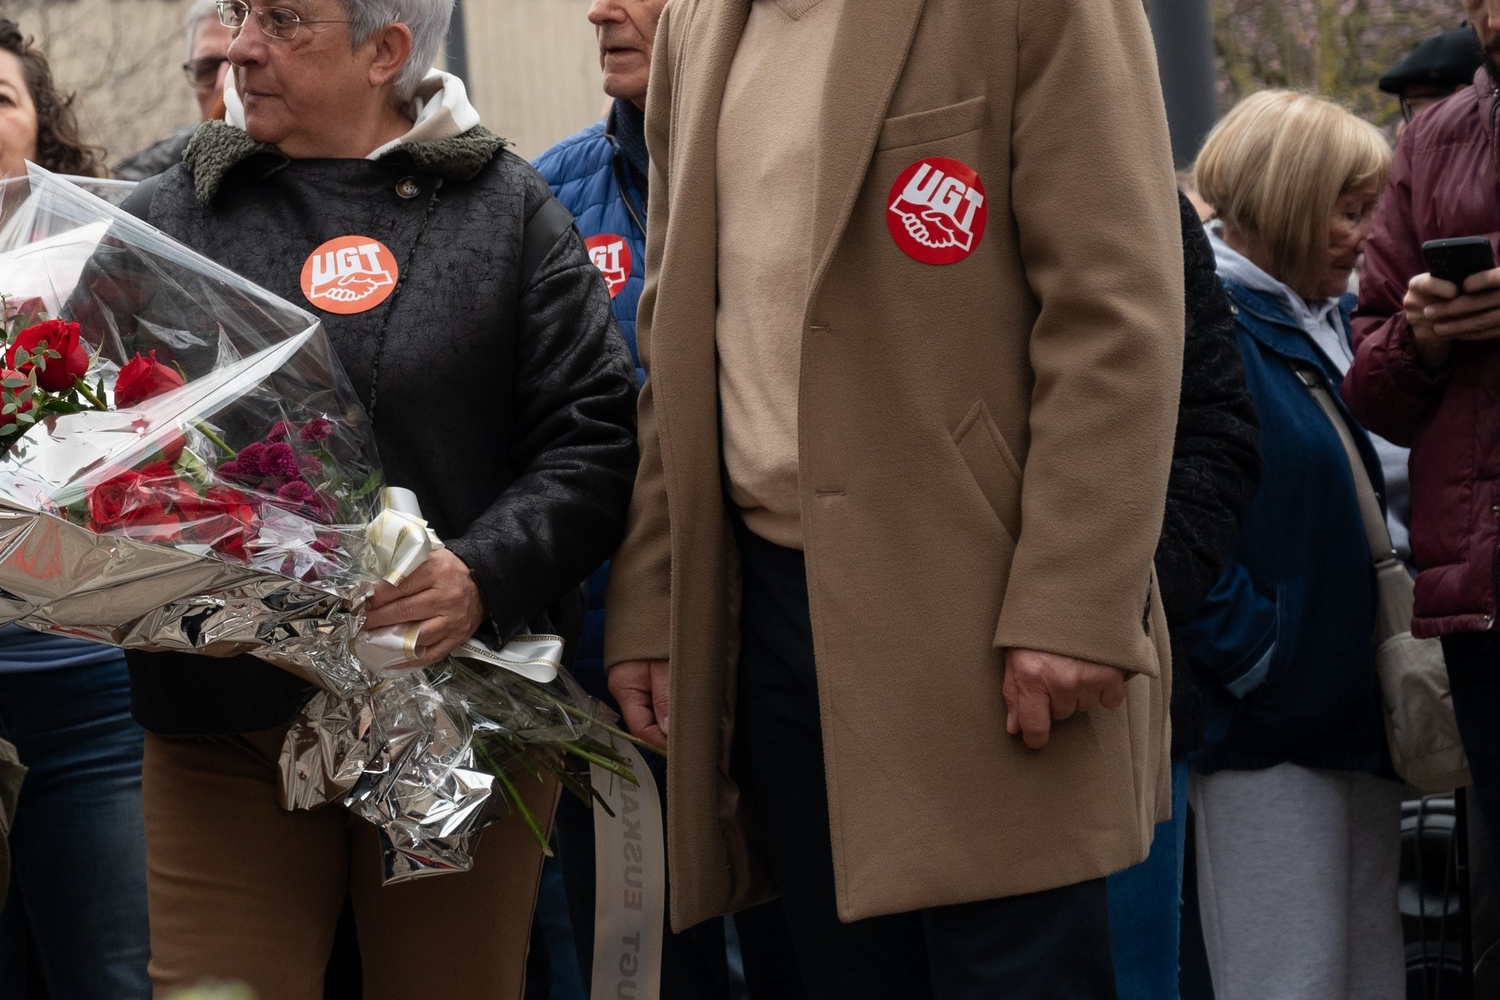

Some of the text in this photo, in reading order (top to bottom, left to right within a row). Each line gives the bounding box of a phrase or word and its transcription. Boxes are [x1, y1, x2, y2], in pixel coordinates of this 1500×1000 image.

[902, 163, 984, 232] UGT
[311, 243, 382, 284] UGT
[589, 240, 623, 272] GT
